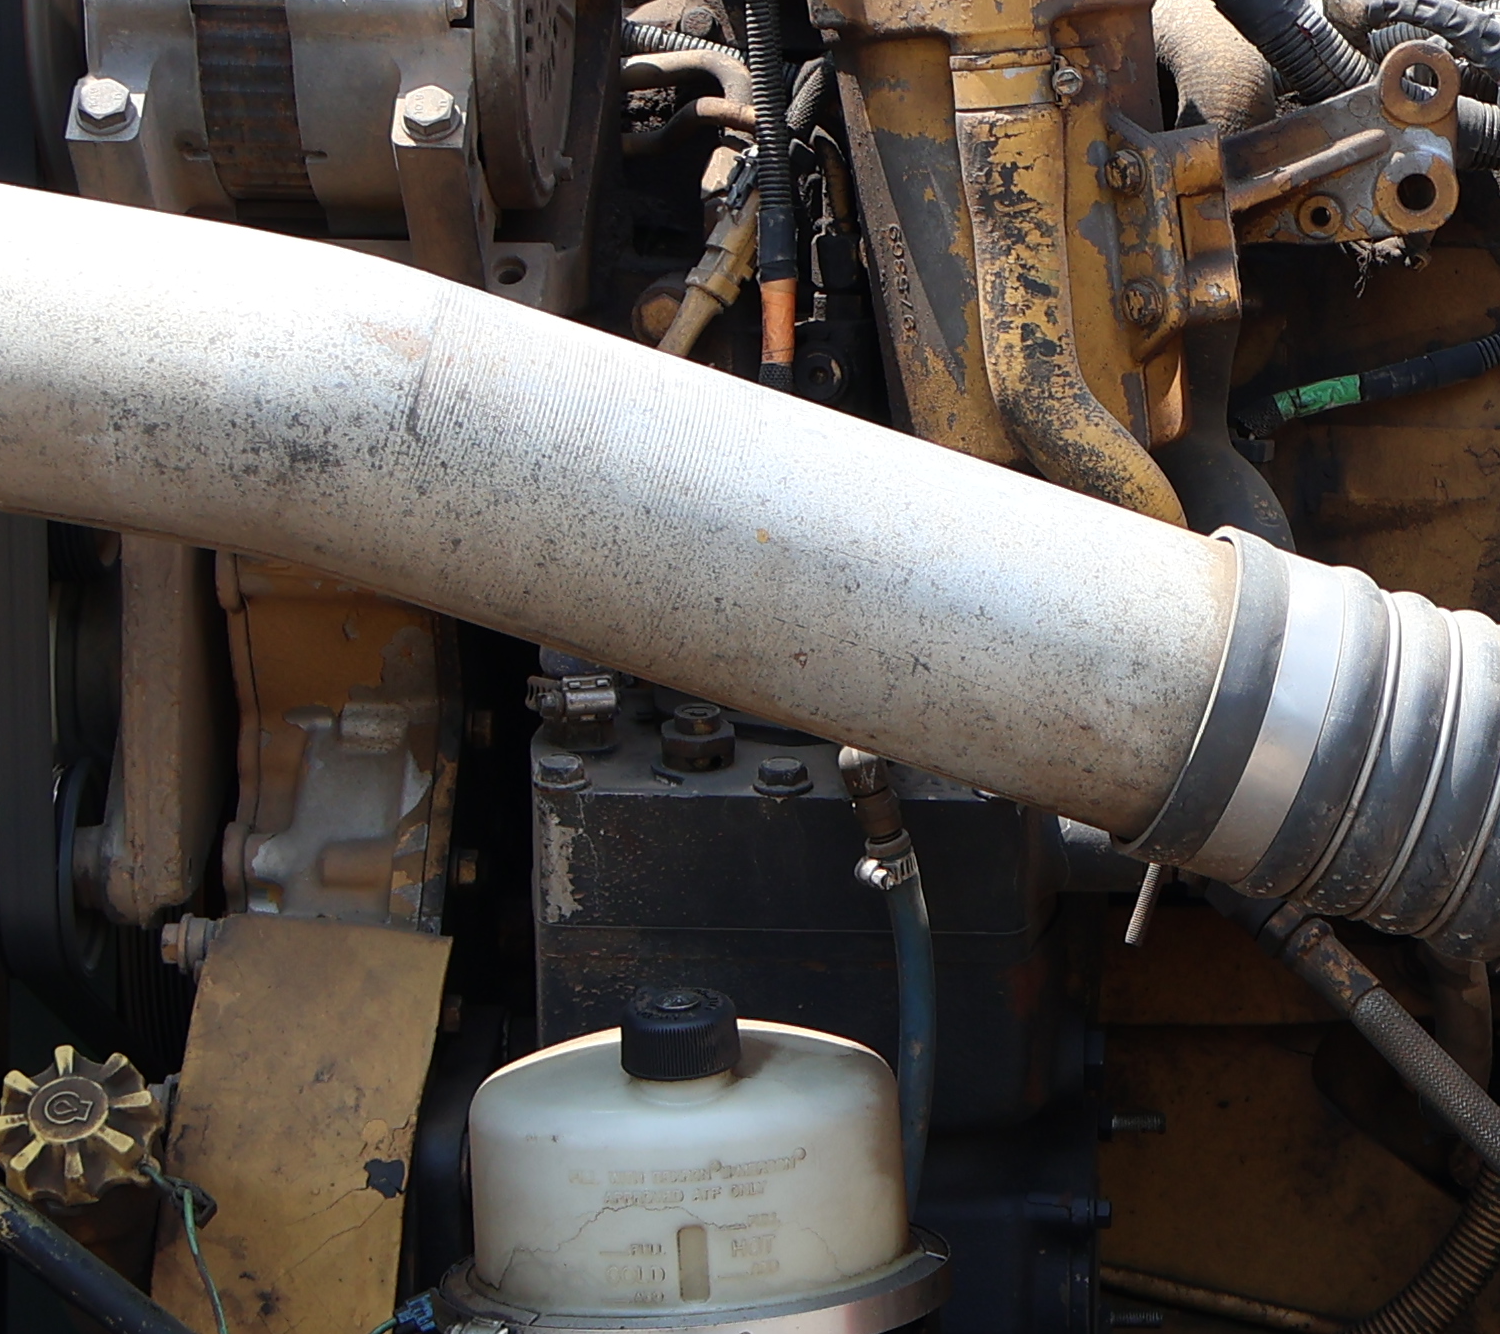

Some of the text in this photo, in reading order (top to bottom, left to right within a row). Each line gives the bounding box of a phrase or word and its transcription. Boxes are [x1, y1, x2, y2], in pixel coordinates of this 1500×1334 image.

[692, 1187, 721, 1202] ATF
[731, 1182, 768, 1198] ONLY
[731, 1235, 775, 1258] HOT
[606, 1265, 666, 1284] COLD
